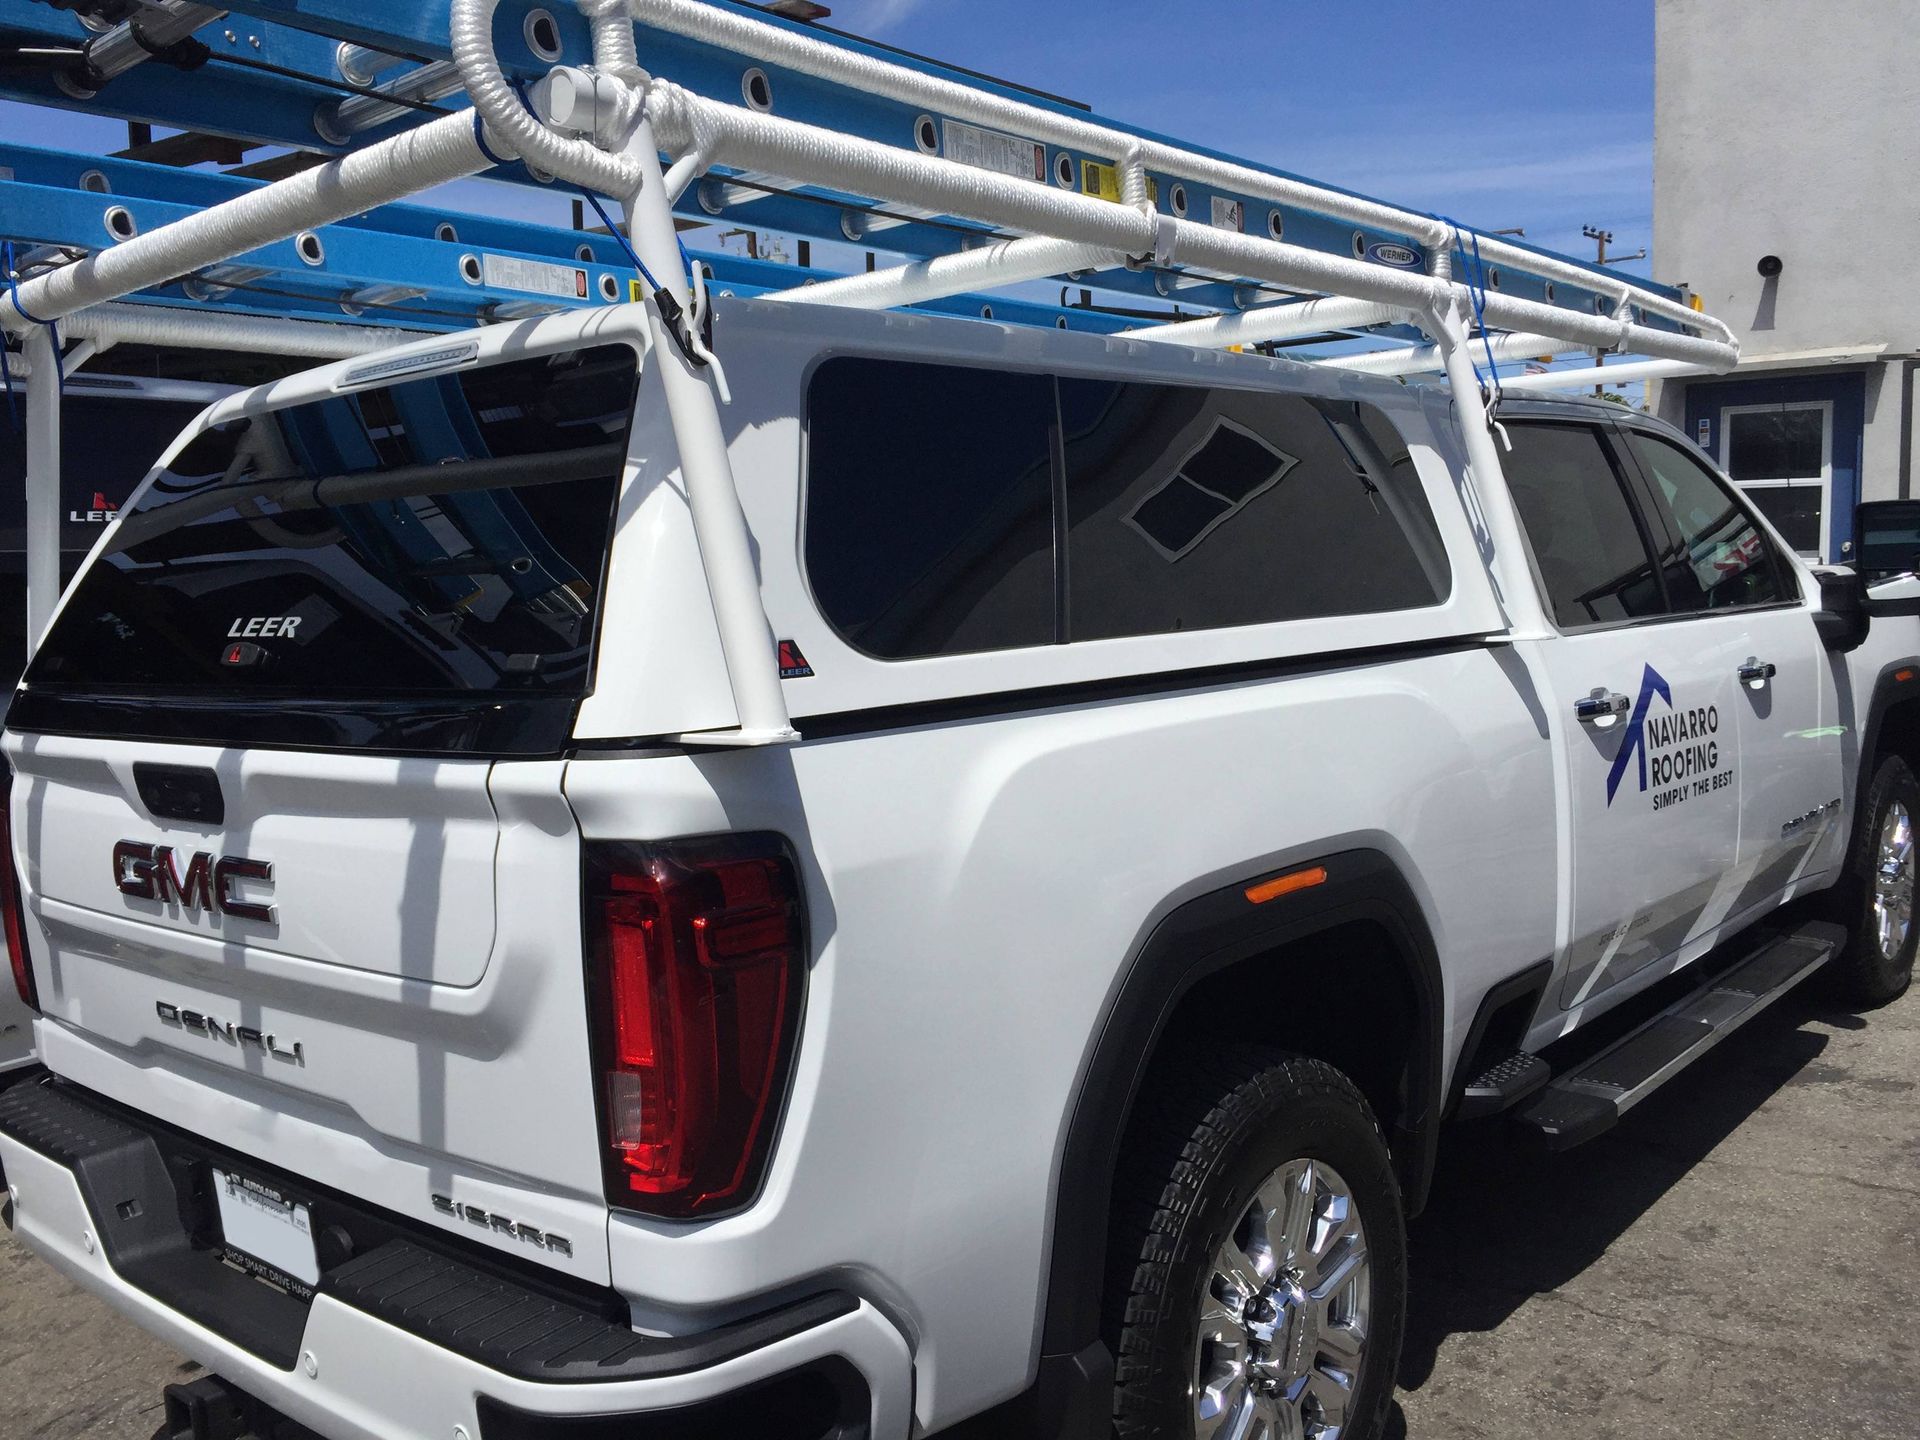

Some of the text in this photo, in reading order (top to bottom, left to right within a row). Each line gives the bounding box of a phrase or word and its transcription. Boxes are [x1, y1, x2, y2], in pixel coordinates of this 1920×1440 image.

[1380, 248, 1411, 261] WERNER
[70, 511, 118, 521] LEE
[227, 616, 302, 638] LEER
[781, 667, 811, 676] LEER
[1648, 705, 1718, 750] NAVARRO
[1652, 741, 1718, 787] ROOFING
[1653, 770, 1733, 811] SIMPLY THE BEST
[113, 839, 278, 924] GMC
[156, 1001, 304, 1066] DENALI
[432, 1194, 573, 1257] SIERRA
[225, 1248, 244, 1265] SHOP
[269, 1270, 291, 1290] DRIVE
[291, 1280, 313, 1301] HAPP
